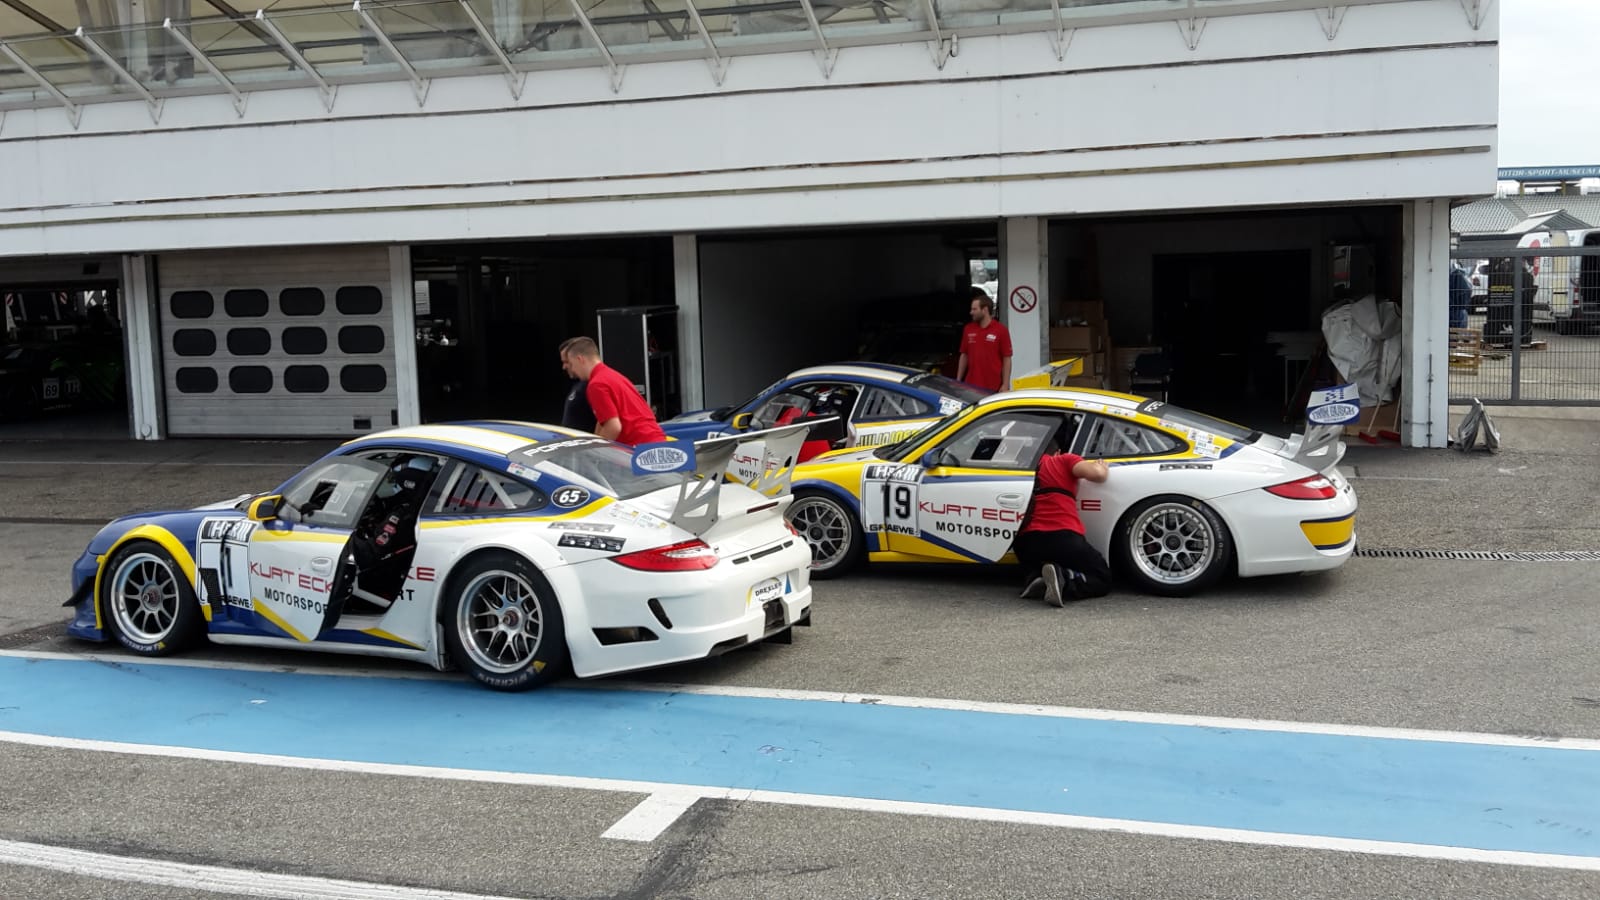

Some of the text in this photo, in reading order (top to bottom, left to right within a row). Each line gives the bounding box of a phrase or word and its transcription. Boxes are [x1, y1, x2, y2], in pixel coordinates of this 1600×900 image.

[559, 490, 581, 504] 65
[881, 485, 911, 519] 19
[919, 501, 977, 518] KURT
[250, 562, 295, 582] KURT
